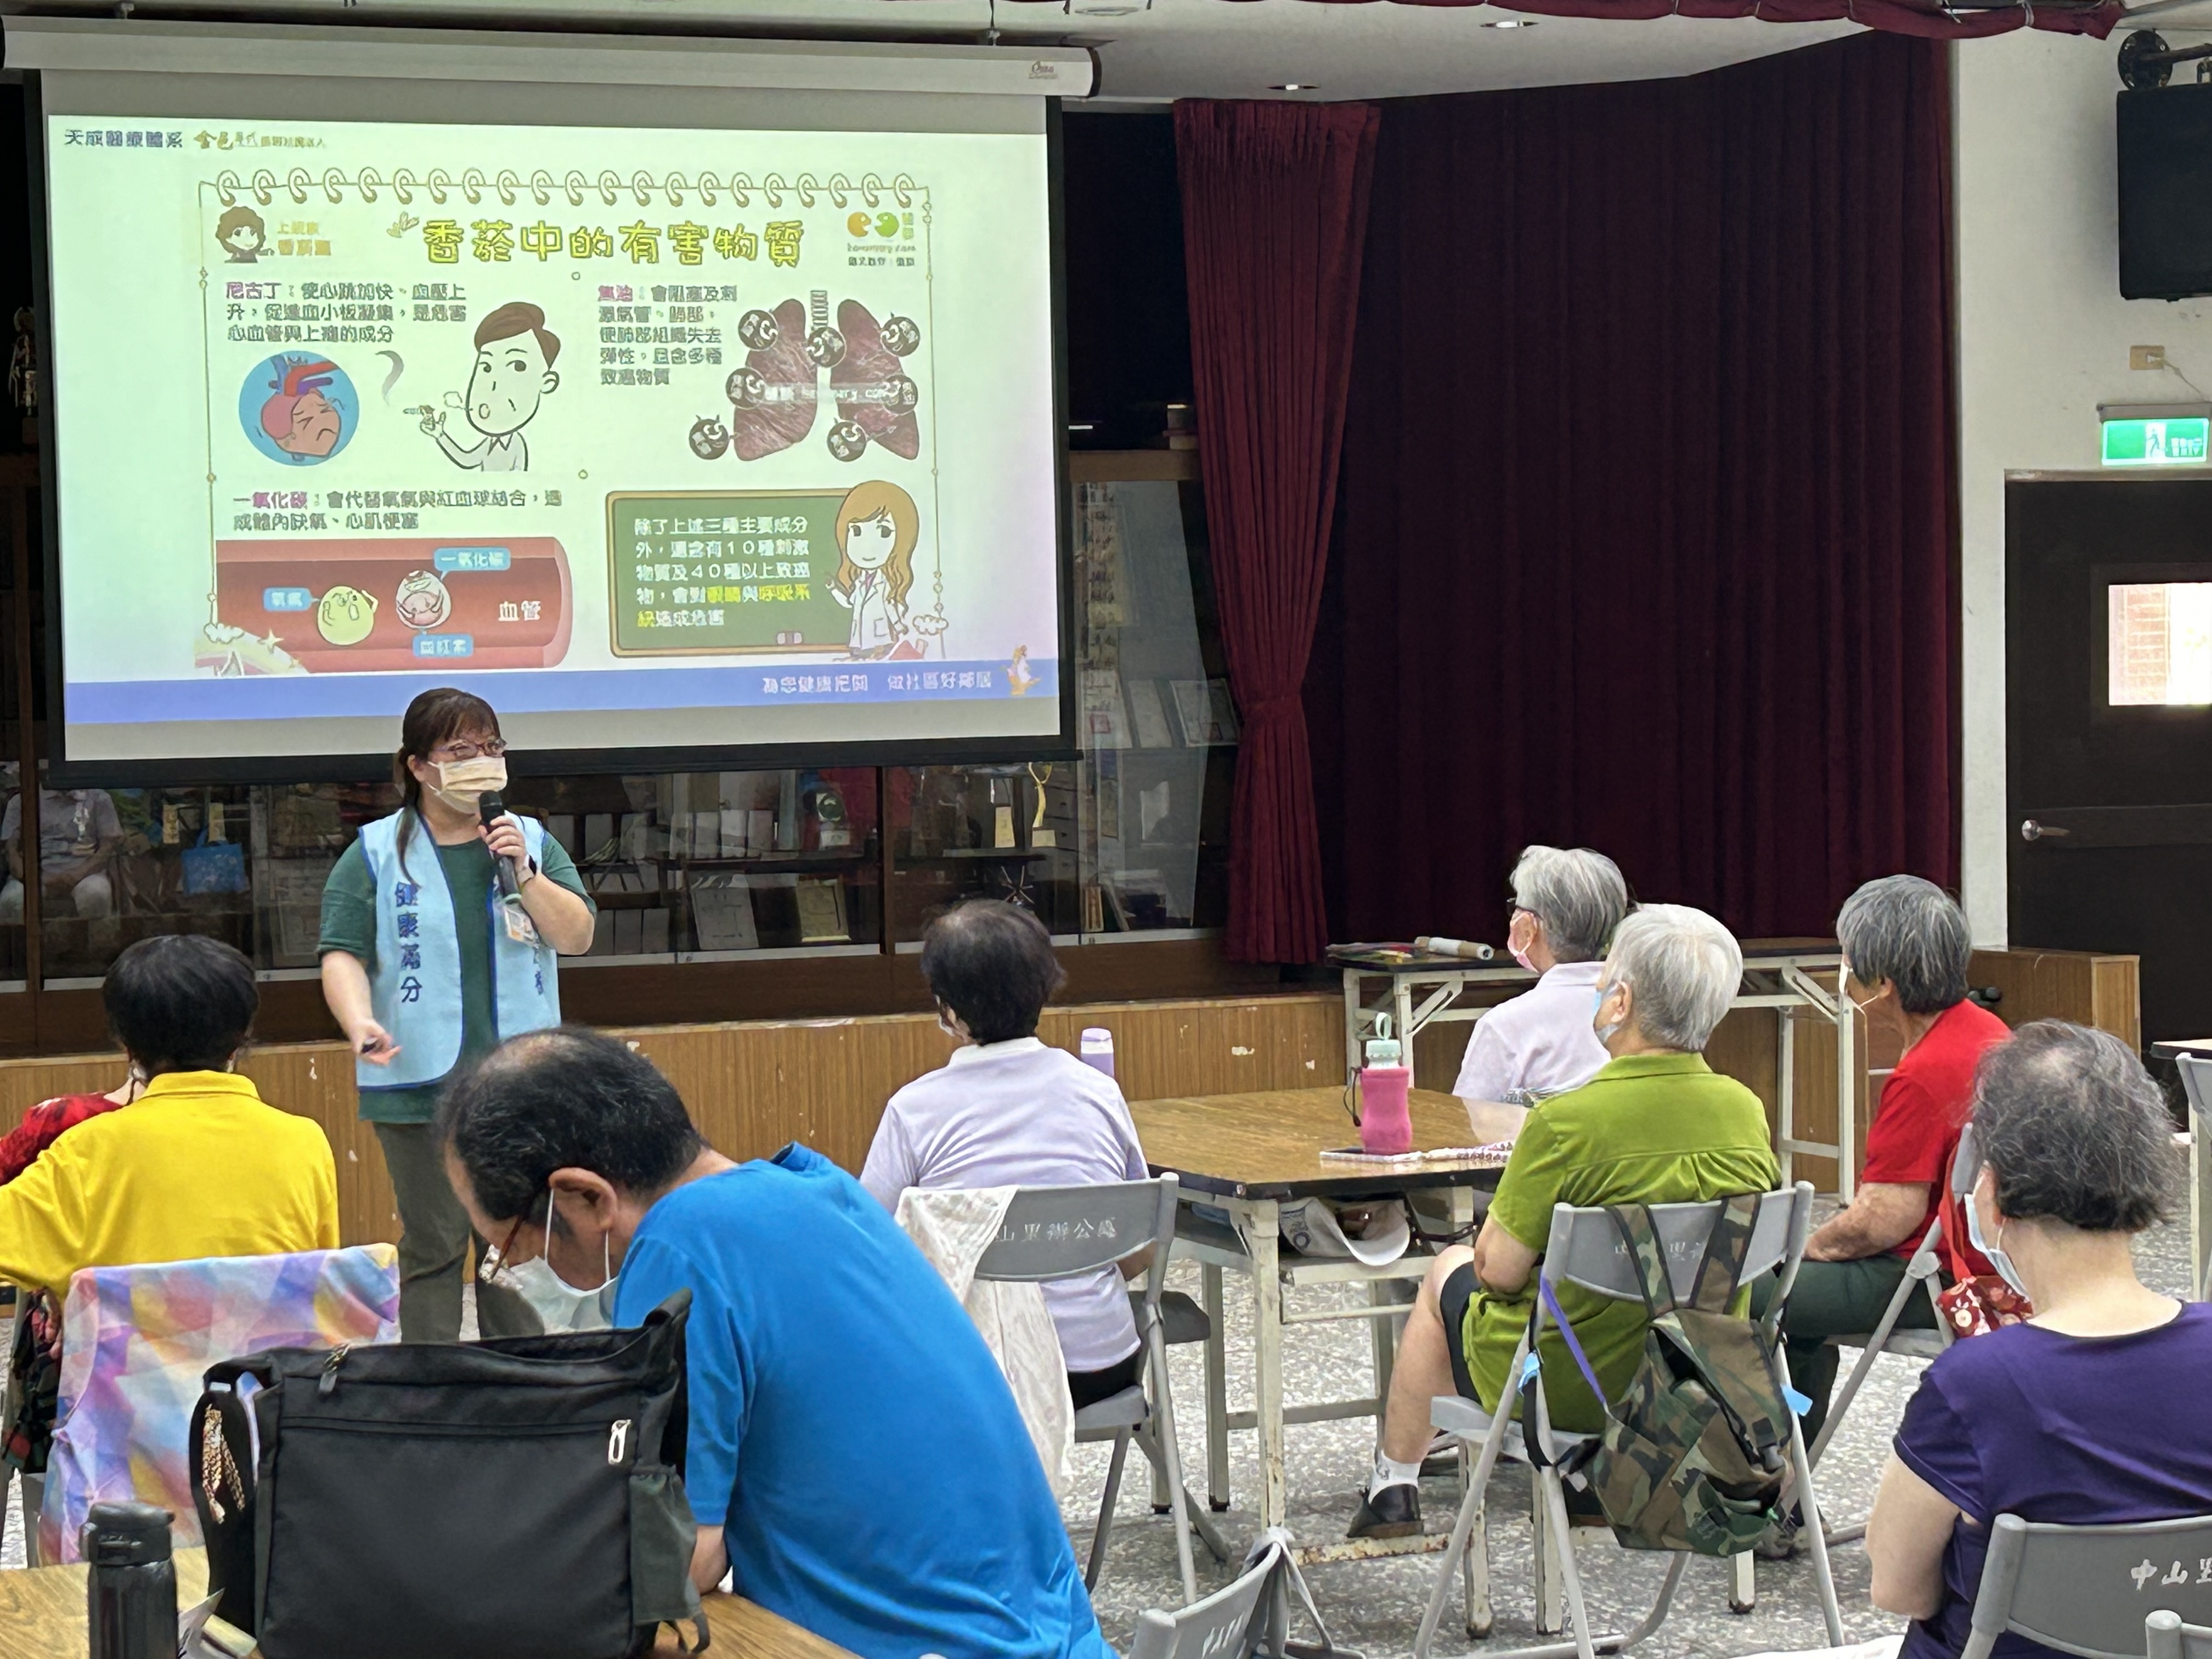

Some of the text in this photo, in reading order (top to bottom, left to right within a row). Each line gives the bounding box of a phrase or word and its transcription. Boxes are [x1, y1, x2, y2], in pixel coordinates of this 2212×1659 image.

[422, 219, 804, 268] 香菸中的有害物質
[498, 600, 541, 622] 血管
[394, 881, 422, 1003] 健康滿分
